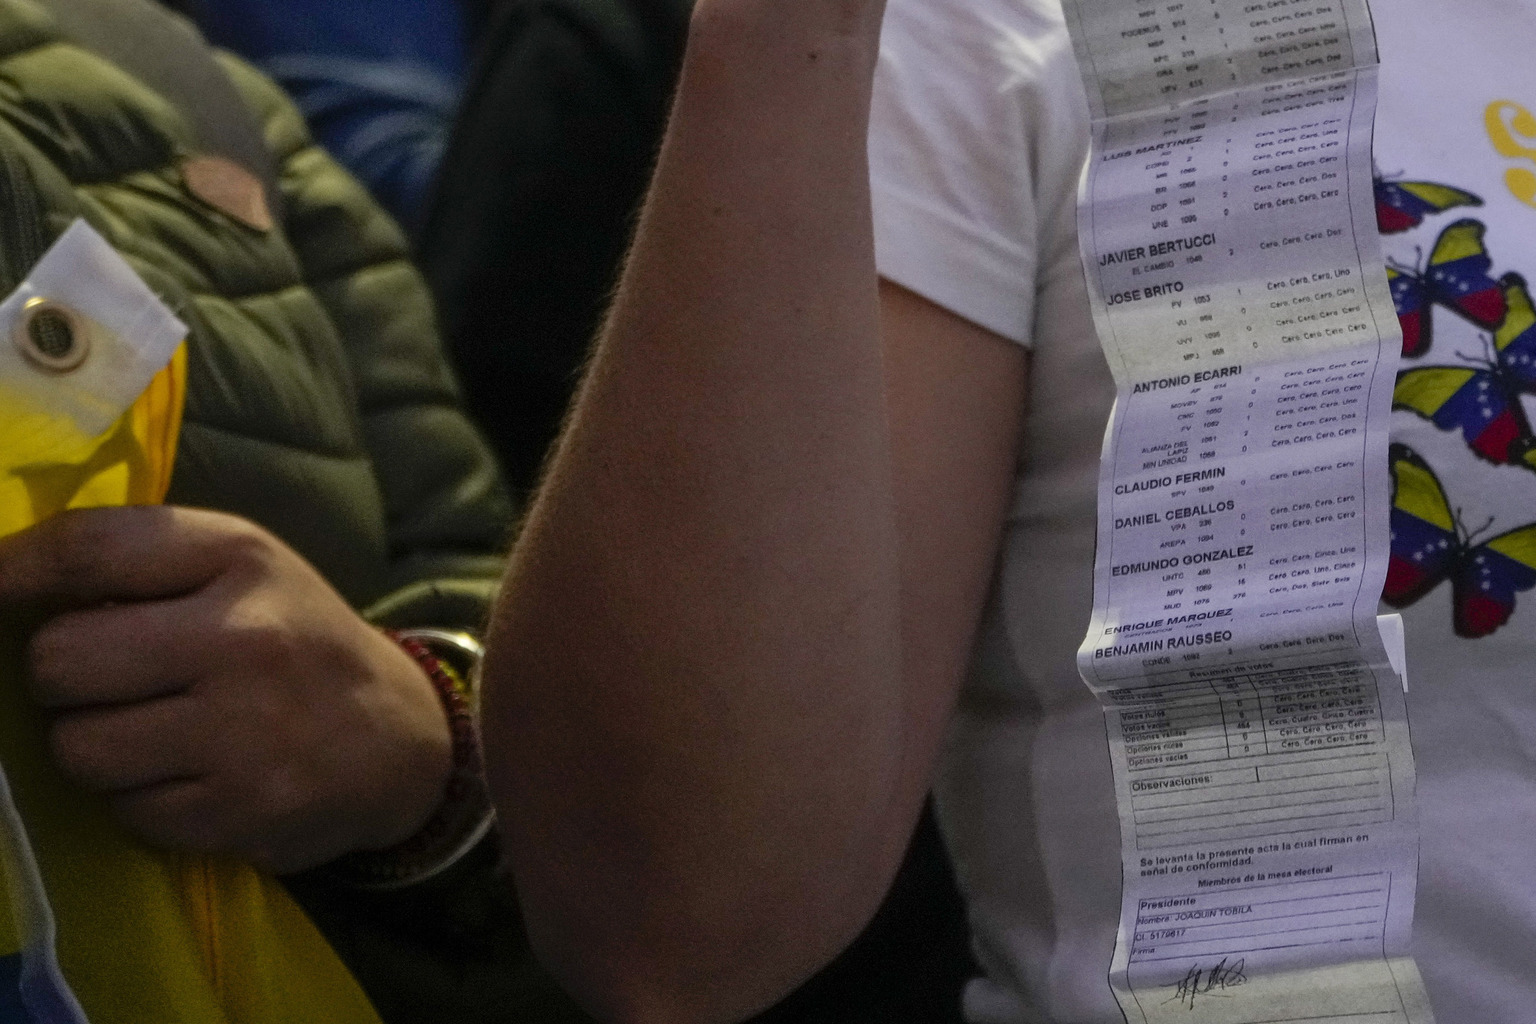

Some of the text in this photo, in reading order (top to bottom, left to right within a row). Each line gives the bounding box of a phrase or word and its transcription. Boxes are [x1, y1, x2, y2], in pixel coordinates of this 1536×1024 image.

[1136, 136, 1202, 155] MARTINEZ
[1100, 233, 1216, 266] JAVIER BERTUCCI
[1107, 281, 1184, 306] JOSE BRITO
[1133, 365, 1242, 394] ANTONIO ECARRI
[1115, 466, 1226, 495] CLAUDIO FERMIN
[1115, 500, 1235, 530] DANIEL CEBALLOS
[1112, 545, 1254, 577] EDMUNDO GONZALEZ
[1104, 608, 1233, 635] ENRIQUE MARQUEZ
[1096, 640, 1163, 660] BENJAMIN
[1168, 630, 1232, 649] RAUSSEO
[1140, 834, 1370, 867] Se levanta la presente acta la cual firman en
[1171, 864, 1183, 874] de
[1198, 865, 1333, 888] Miembros de la mesa electoral
[1141, 898, 1196, 910] Presidente
[1175, 910, 1216, 922] JOAQUIN
